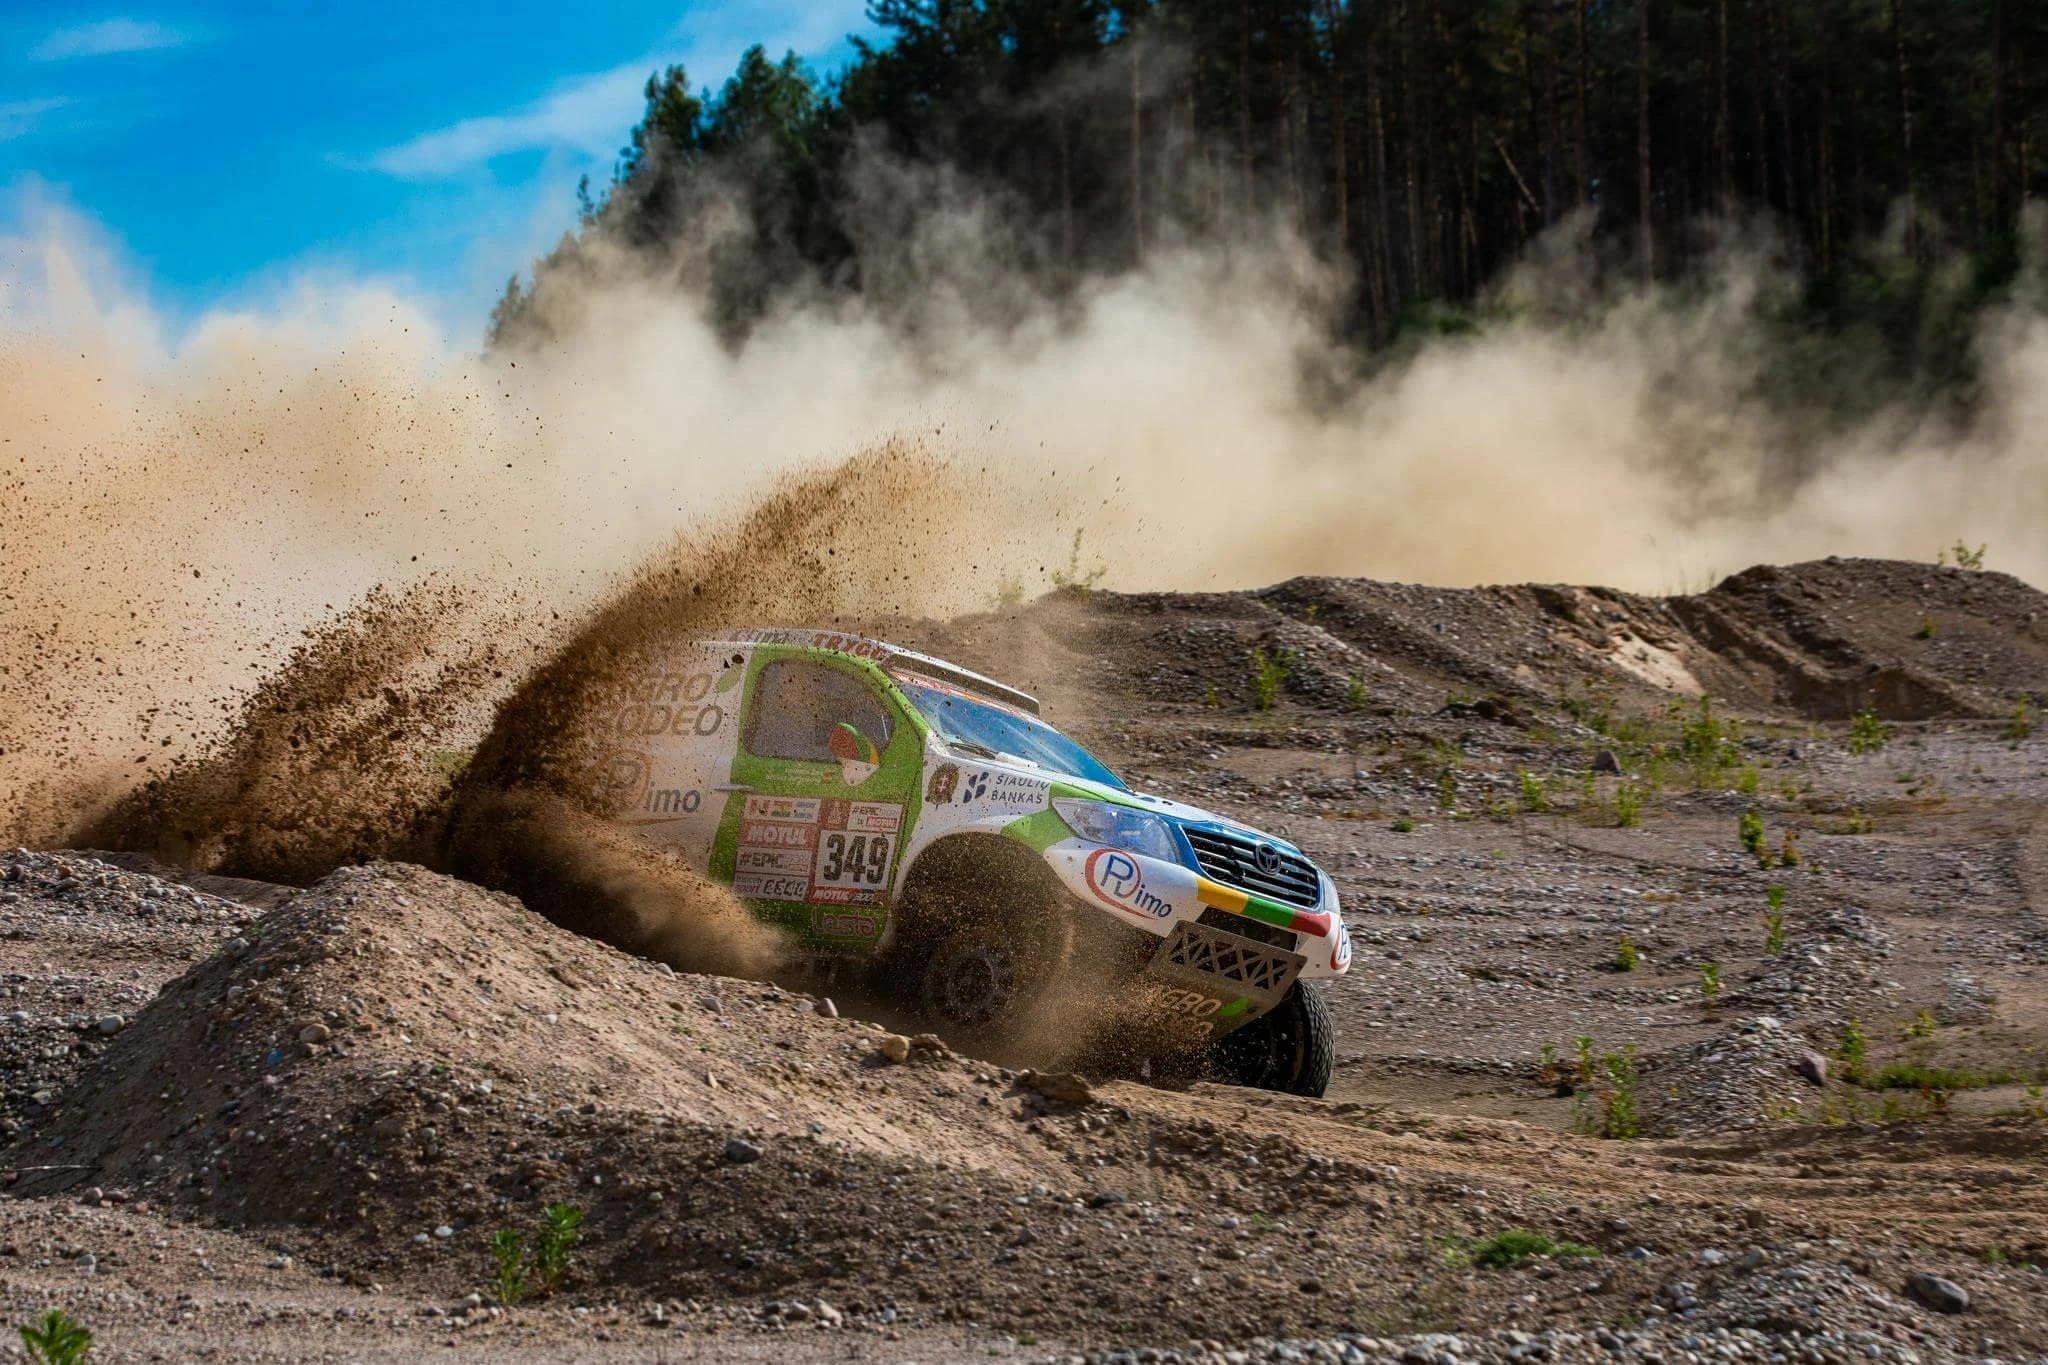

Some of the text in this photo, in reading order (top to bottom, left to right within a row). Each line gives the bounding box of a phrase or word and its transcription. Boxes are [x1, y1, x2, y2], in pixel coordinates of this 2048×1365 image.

[991, 789, 1044, 804] BANKAS
[866, 817, 898, 828] MOTUL
[748, 825, 808, 846] MOTUL
[823, 834, 890, 884] 349
[812, 889, 849, 901] MOTUL
